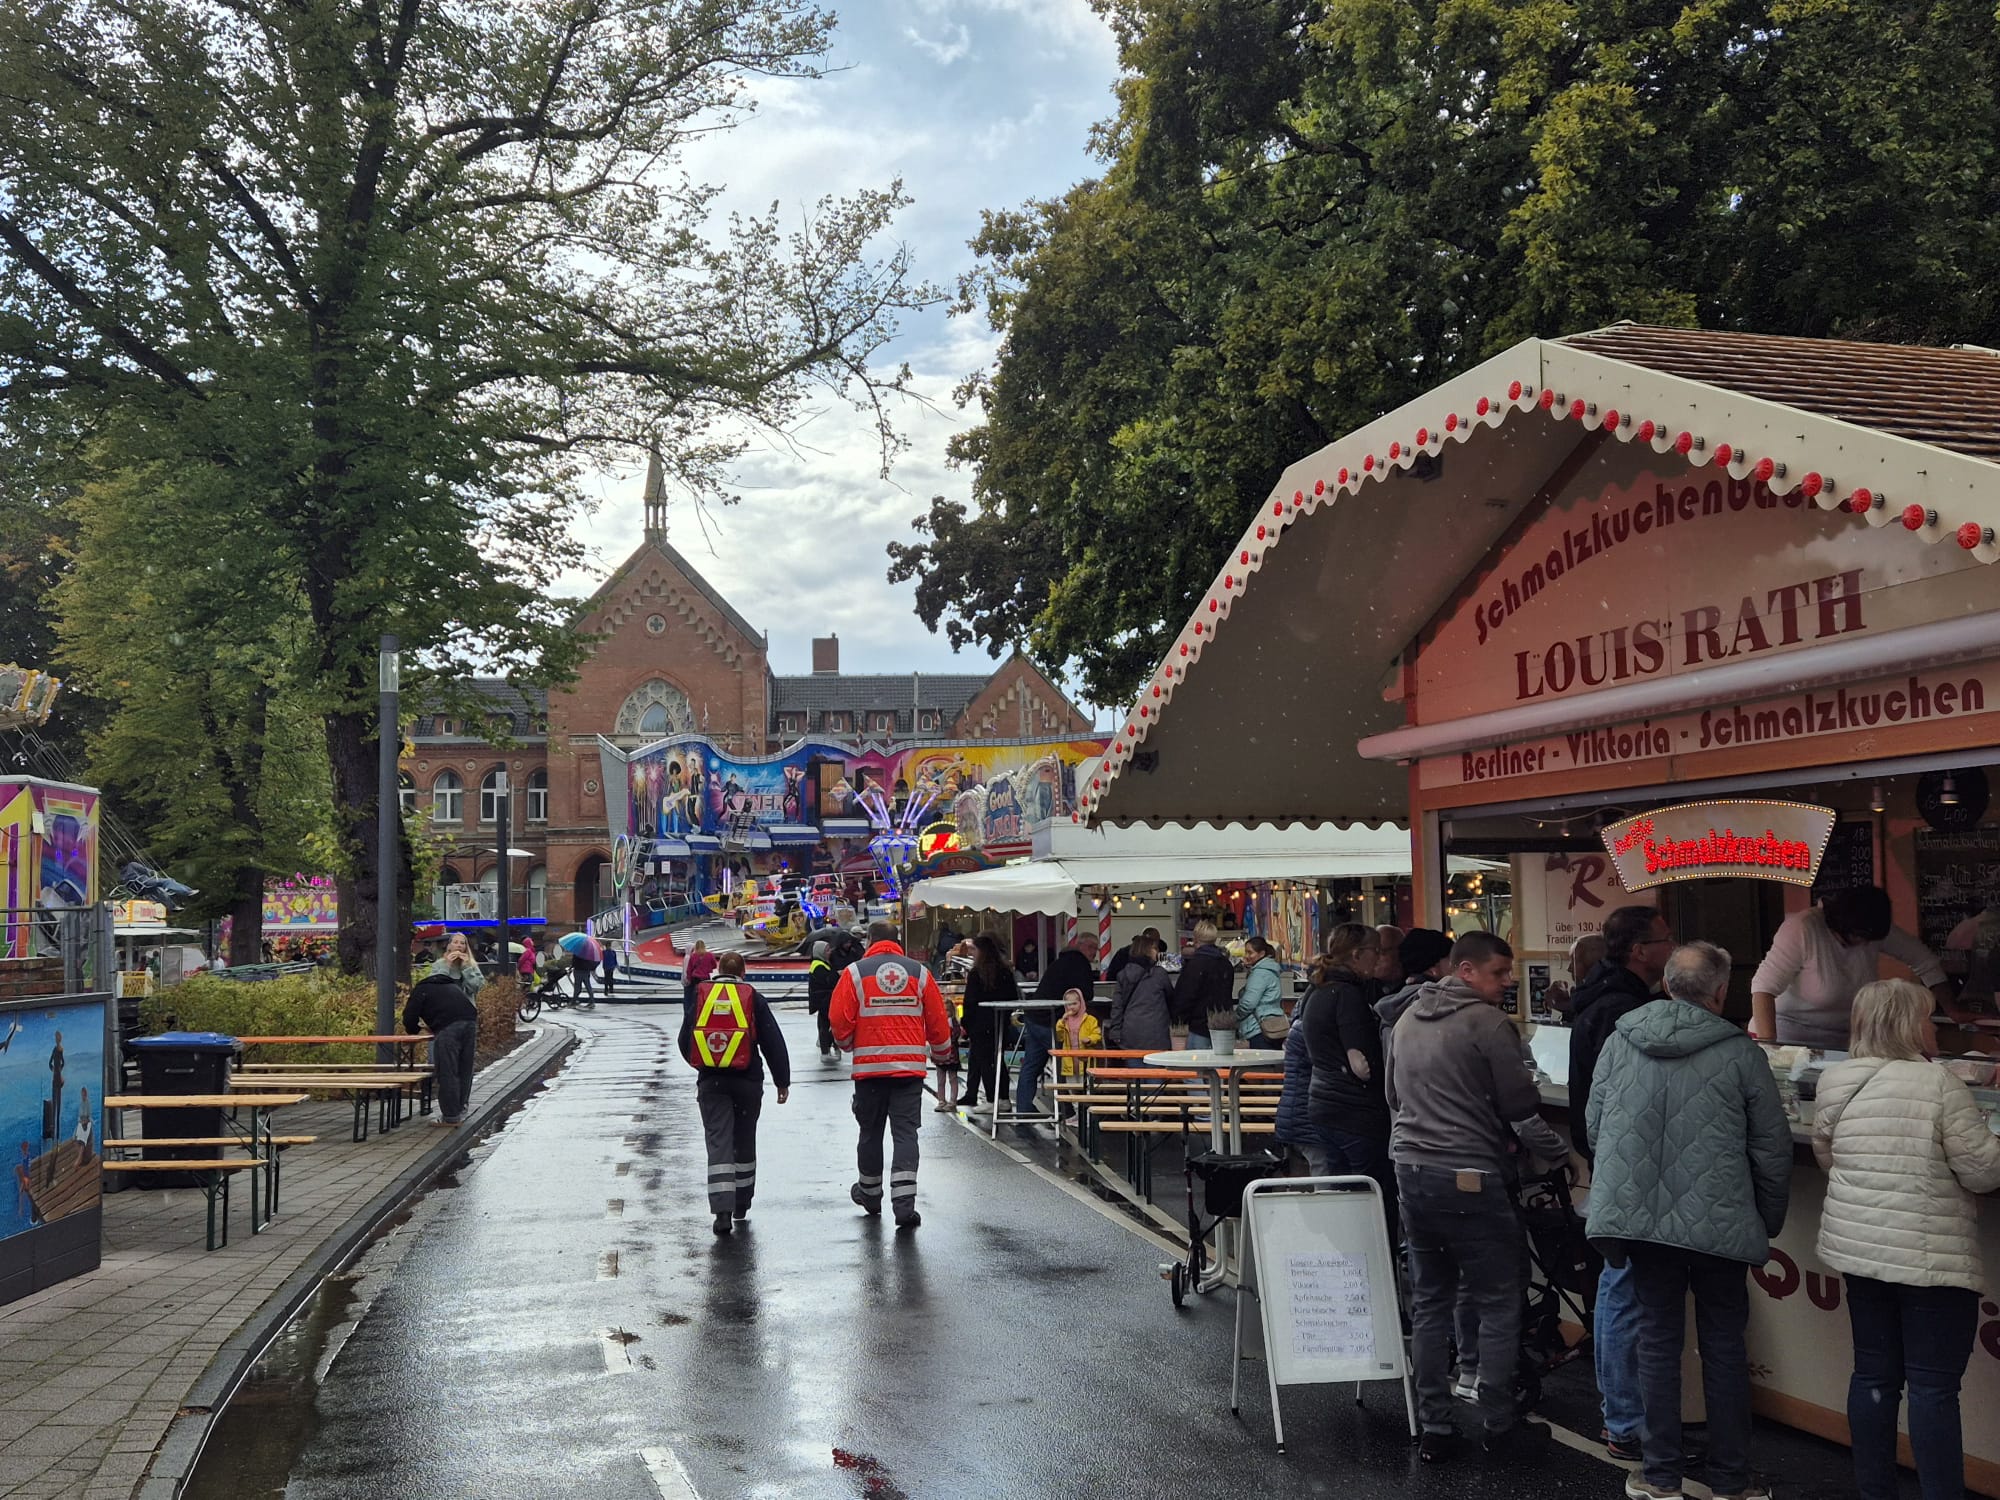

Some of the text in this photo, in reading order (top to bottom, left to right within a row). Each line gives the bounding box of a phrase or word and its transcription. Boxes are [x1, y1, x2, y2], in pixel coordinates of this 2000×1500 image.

[1515, 568, 1867, 700] LOUIS RATH
[1463, 744, 1545, 782] Berliner
[1566, 720, 1670, 767] Viktoria
[1700, 677, 1984, 748] Schmalzkuchen
[1644, 829, 1810, 873] Schmalzkuchen
[1577, 921, 1594, 932] 130
